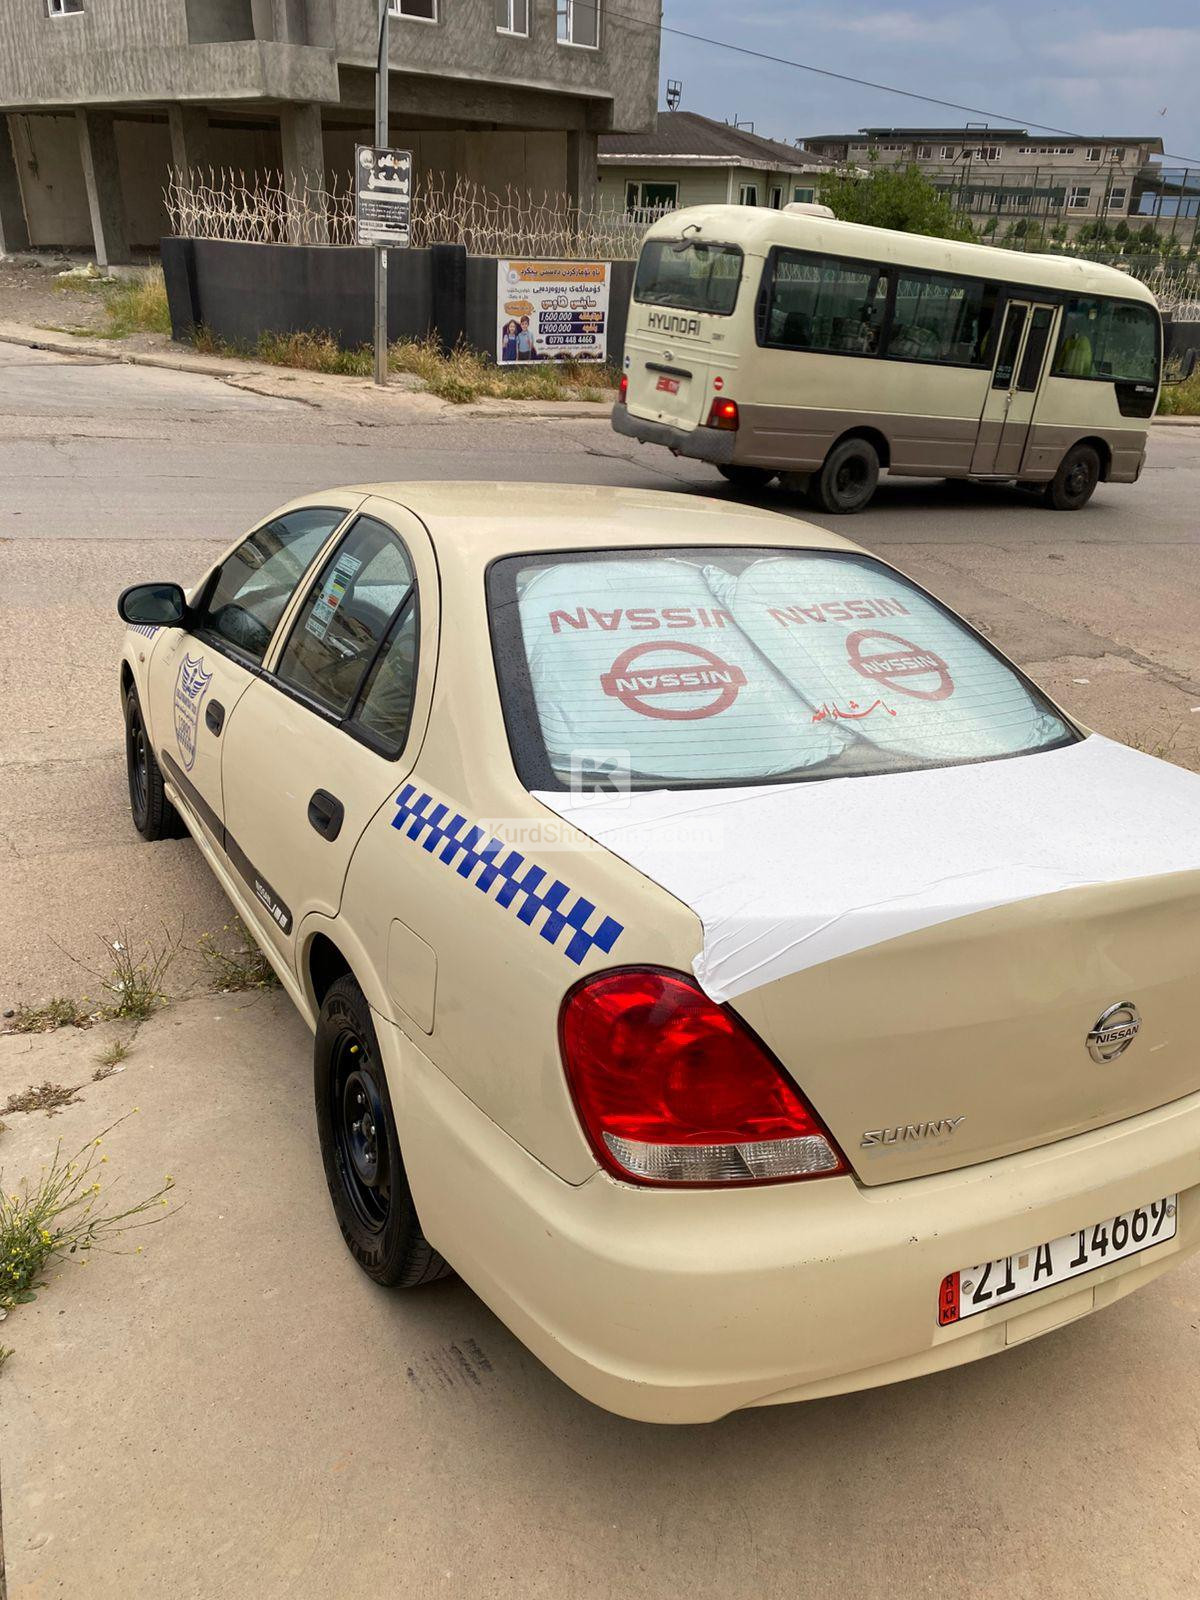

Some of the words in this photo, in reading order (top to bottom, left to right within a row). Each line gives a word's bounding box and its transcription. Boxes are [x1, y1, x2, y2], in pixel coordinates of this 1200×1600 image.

[648, 313, 701, 336] HYUNDAI
[549, 607, 735, 633] NISSAN
[766, 598, 911, 628] NISSAN
[861, 655, 938, 674] NISSAN
[615, 670, 732, 692] NISSAN
[1096, 1025, 1140, 1046] NISSAN
[860, 1116, 966, 1149] SUNNY
[972, 1256, 1015, 1304] 21
[1033, 1242, 1053, 1281] A
